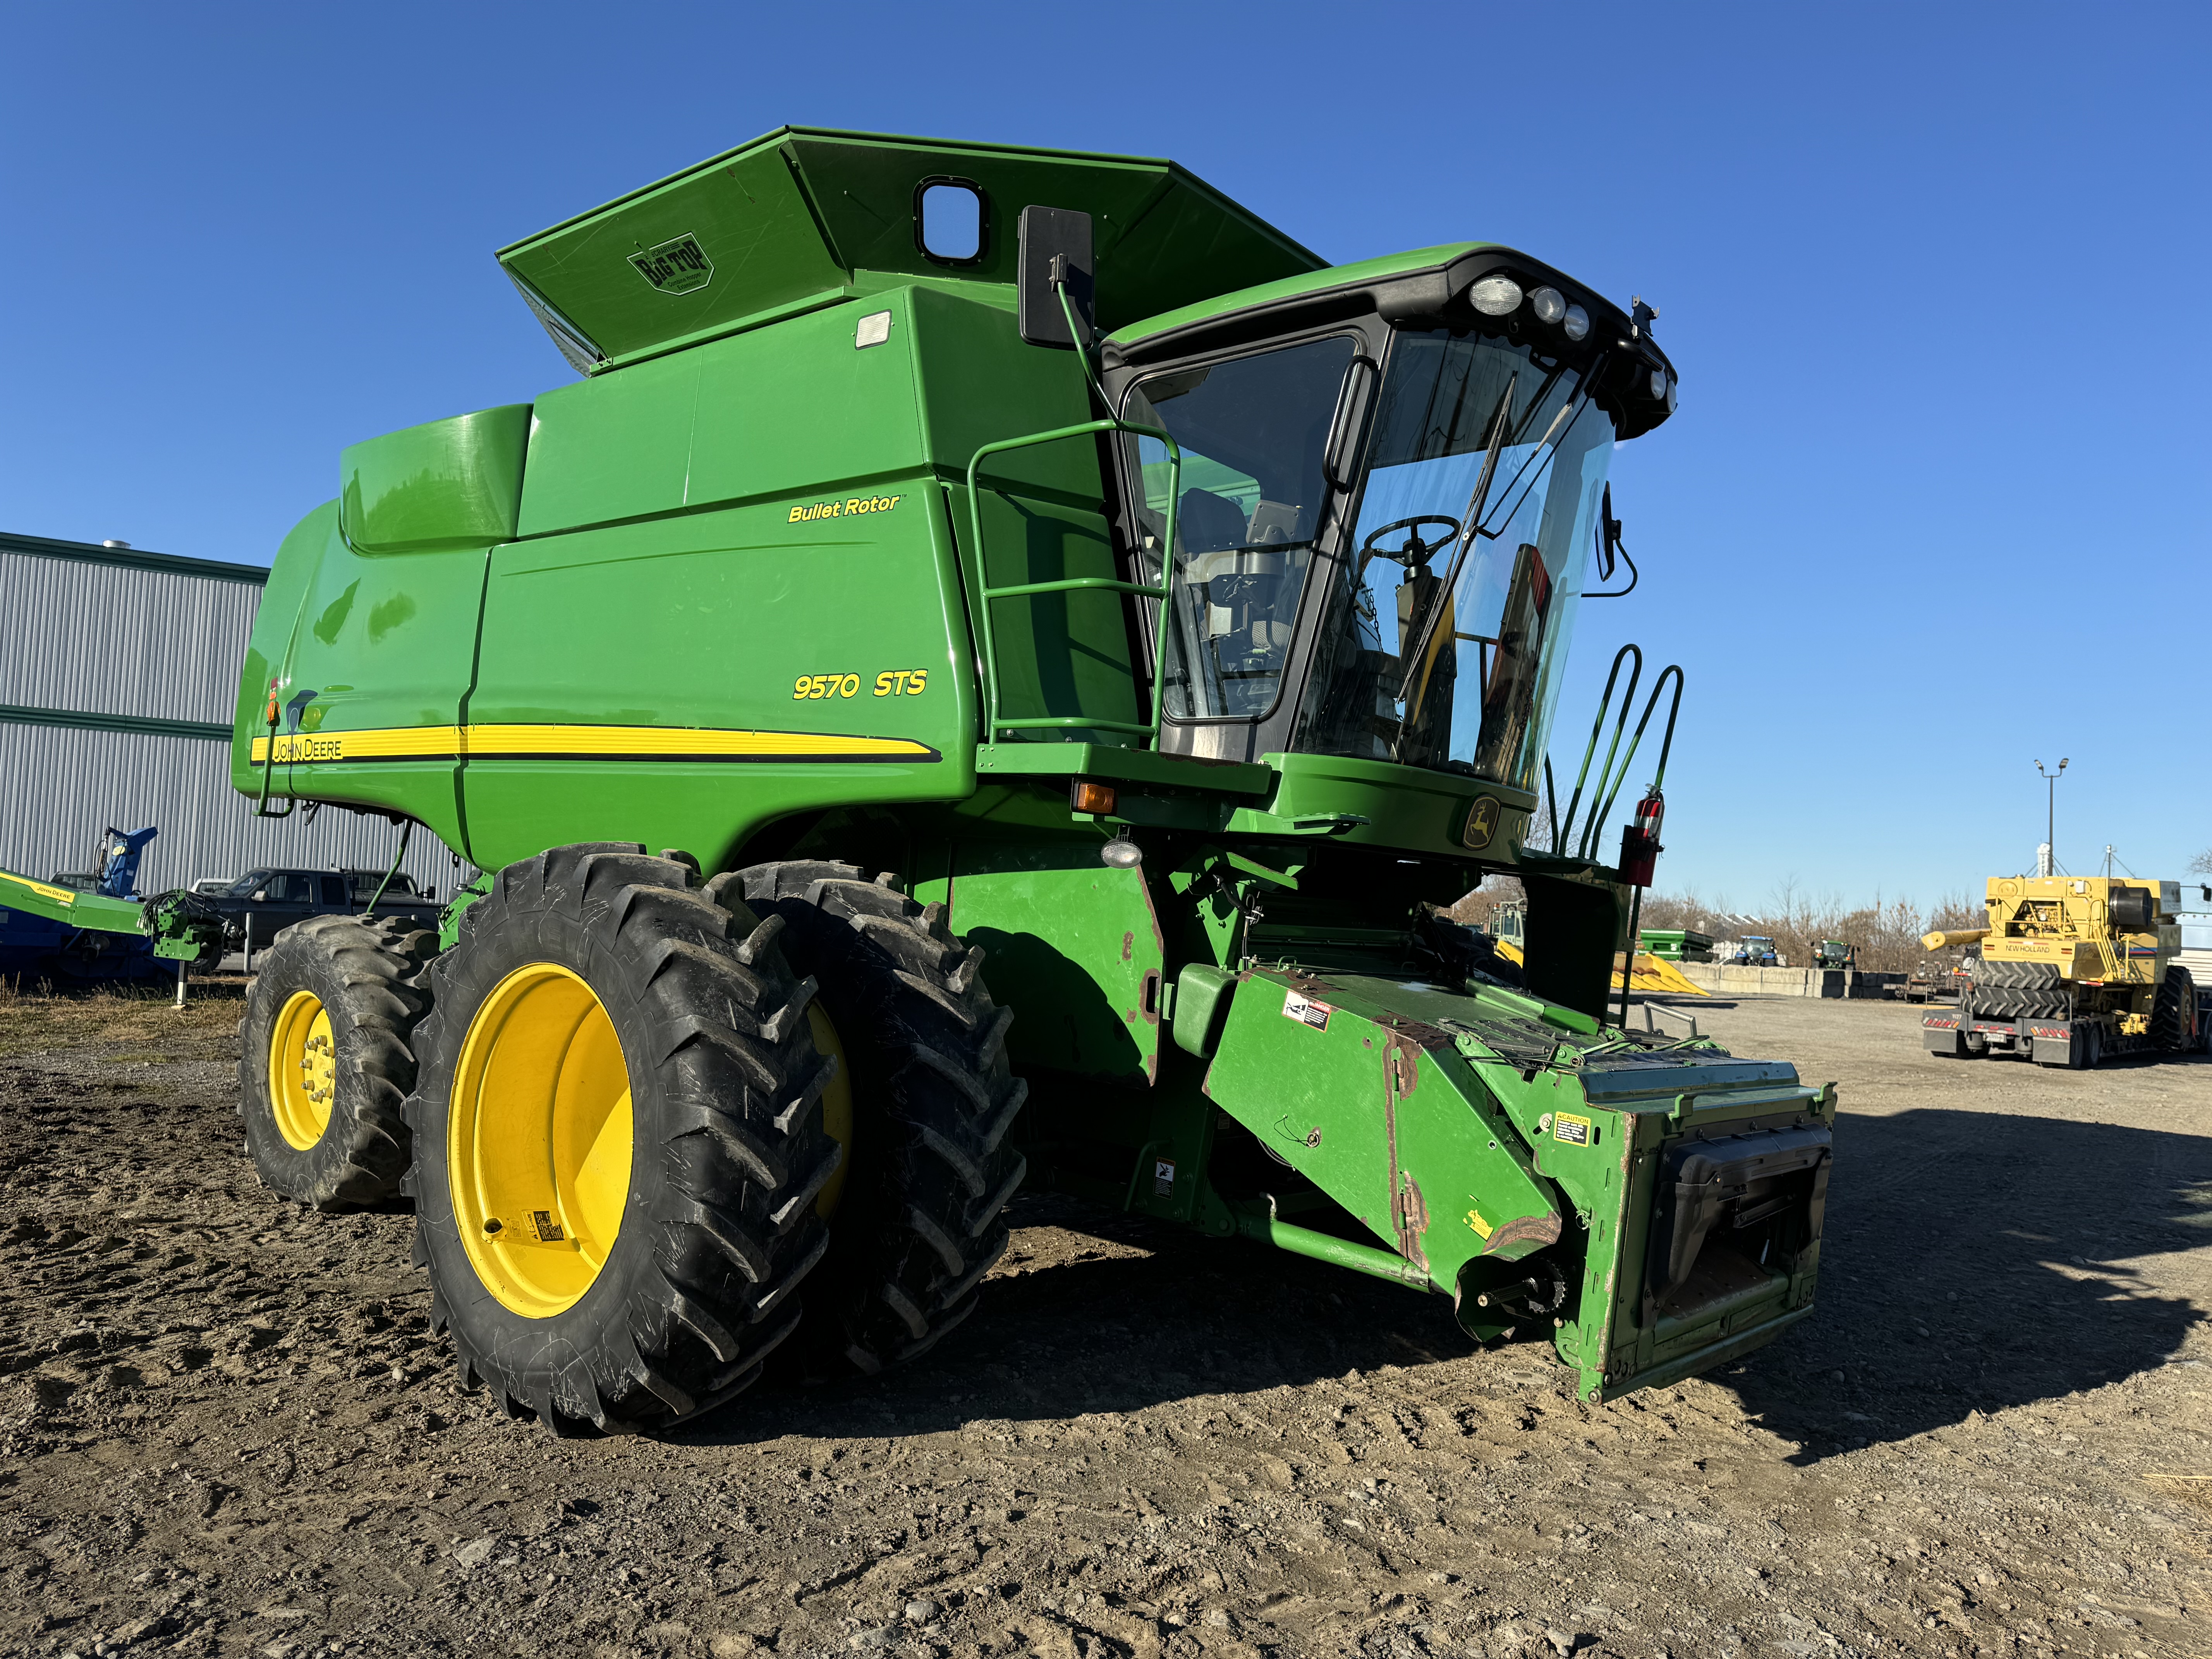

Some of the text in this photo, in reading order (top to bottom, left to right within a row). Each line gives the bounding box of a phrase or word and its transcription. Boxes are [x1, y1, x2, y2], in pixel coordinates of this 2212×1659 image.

[653, 245, 672, 257] CRARY
[634, 240, 708, 287] BIG TOP
[668, 272, 702, 287] Combine Hopper
[677, 279, 701, 290] Extensions
[787, 501, 842, 524] Bullet
[843, 494, 900, 517] Rotor
[793, 668, 929, 700] 9570 STS
[274, 738, 342, 759] JOHN DEERE
[52, 890, 70, 899] DEERE
[1562, 1114, 1589, 1124] CAUTION
